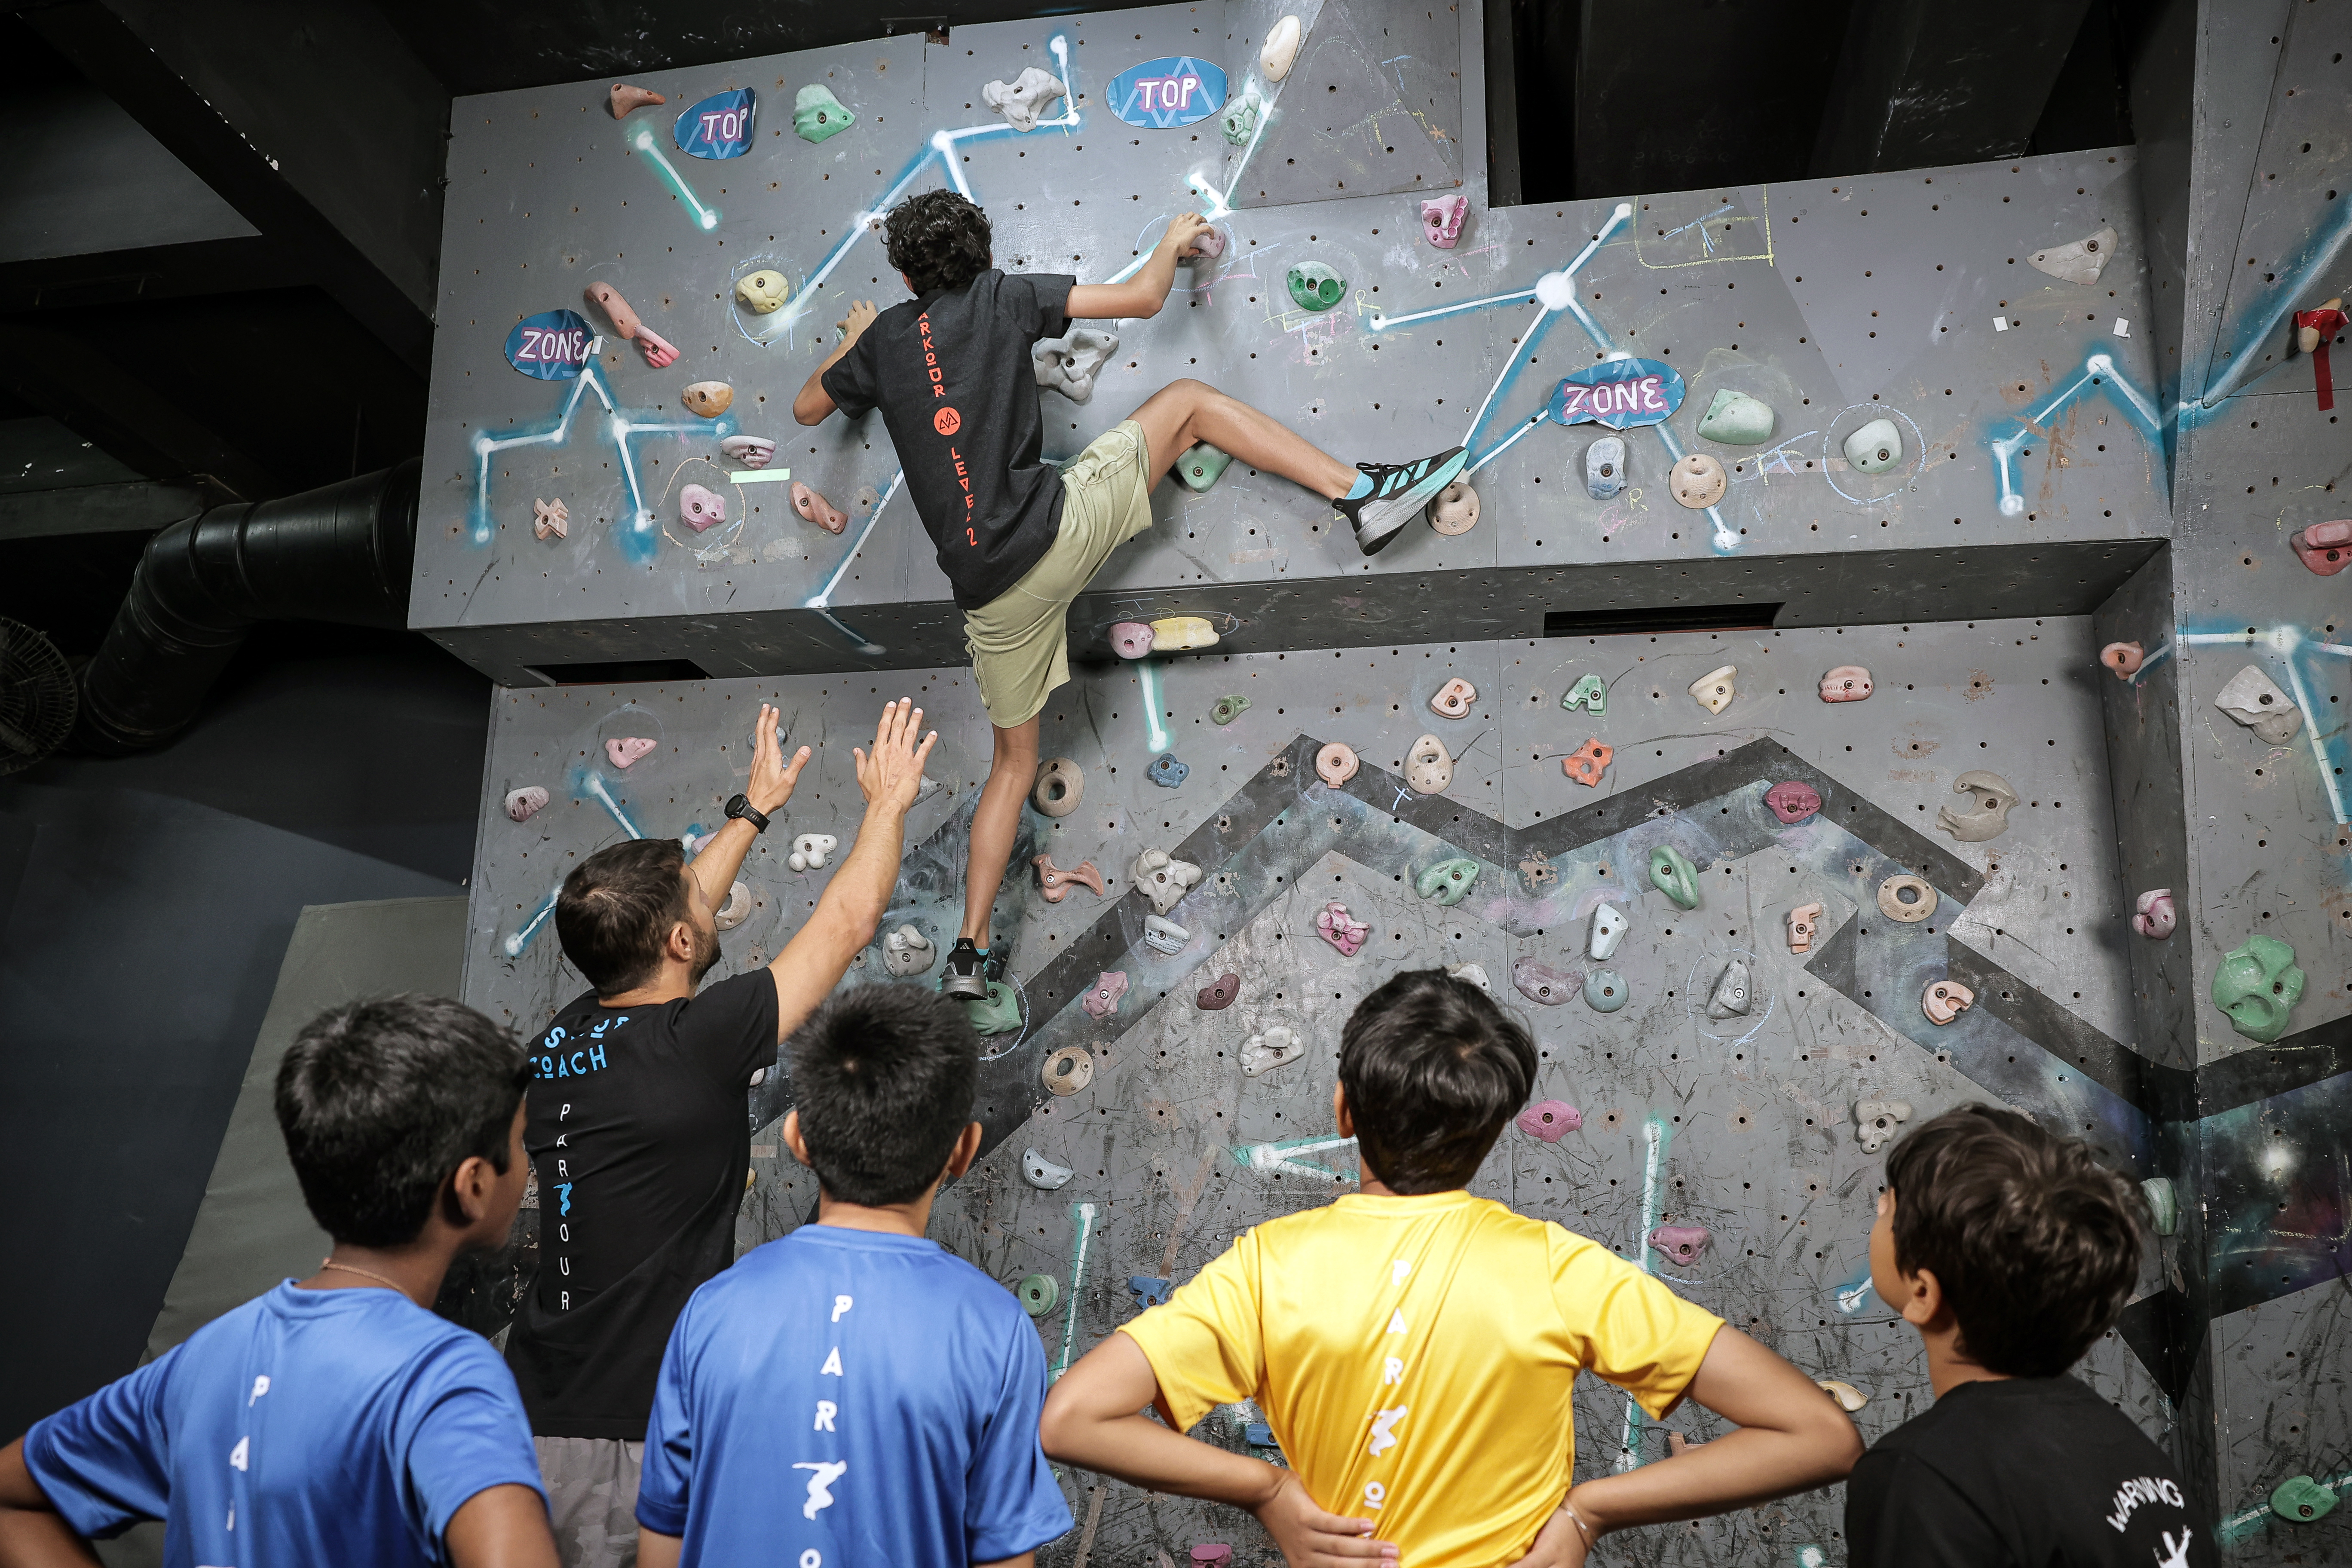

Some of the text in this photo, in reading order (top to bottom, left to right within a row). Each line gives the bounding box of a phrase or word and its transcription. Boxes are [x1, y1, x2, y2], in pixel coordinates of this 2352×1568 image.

[1139, 78, 1197, 109] TOP
[702, 107, 749, 140] TOP
[518, 331, 583, 361] ZONE
[1566, 378, 1663, 414] ZONE
[967, 527, 978, 547] 2
[1363, 1260, 1412, 1539] PARO
[225, 1374, 271, 1531] PA
[2106, 1476, 2185, 1533] WARNING
